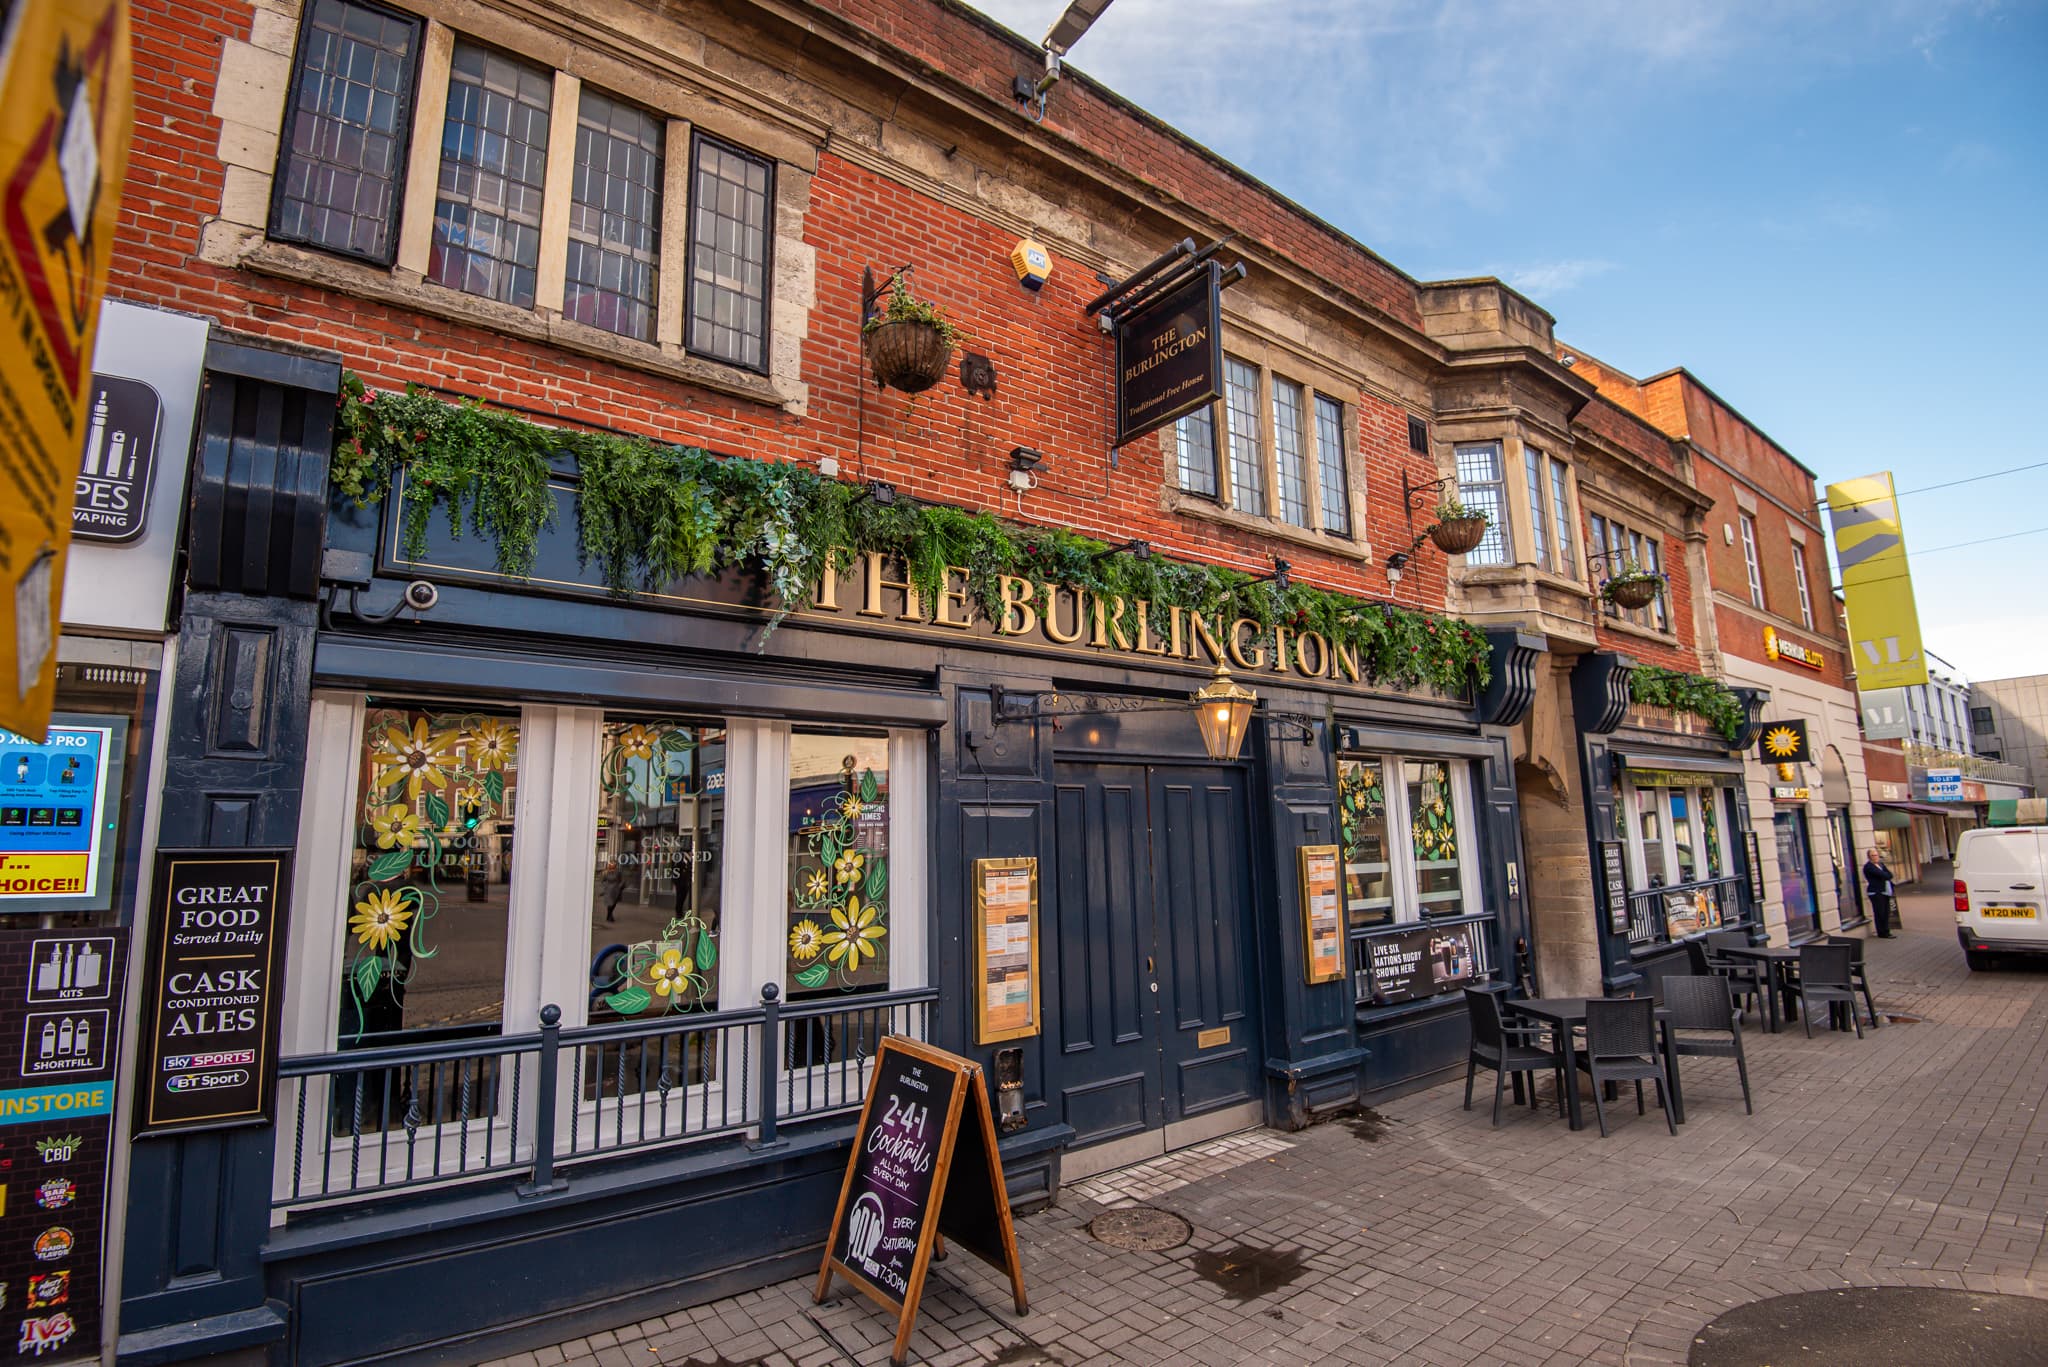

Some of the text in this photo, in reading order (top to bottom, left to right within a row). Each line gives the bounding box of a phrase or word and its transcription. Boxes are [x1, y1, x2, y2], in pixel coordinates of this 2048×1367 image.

[1152, 327, 1177, 351] THE
[1125, 326, 1208, 383] BURLINGTON
[1128, 373, 1205, 417] Traditional Free House
[72, 512, 128, 527] VAPING
[814, 545, 1360, 683] THE BURLINGTON
[8, 734, 88, 747] XRS PRO
[1941, 784, 1959, 792] FHP
[861, 812, 882, 821] TIMES
[641, 836, 681, 848] CASK
[644, 867, 681, 880] ALES
[1608, 880, 1623, 891] CASK
[176, 886, 268, 905] GREAT
[180, 908, 260, 929] FOOD
[173, 930, 264, 945] Served Daily
[1373, 943, 1400, 956] LIVE SIX
[1374, 951, 1422, 968] NATIONS RUGBY
[1375, 963, 1416, 978] SHOWN HERE
[168, 969, 261, 995] CASK
[58, 988, 85, 998] KITS
[167, 994, 260, 1010] CONDITIONED
[167, 1008, 257, 1037] ALES
[33, 1058, 94, 1071] SHORTFILL
[167, 1051, 251, 1070] sky SPORTS
[177, 1072, 240, 1089] BT Sport
[912, 1066, 922, 1078] THE
[899, 1073, 929, 1093] BURLINGTON
[882, 1094, 928, 1140] 2-4-1
[44, 1145, 72, 1163] CBD
[867, 1124, 931, 1173] Cocktails
[880, 1157, 908, 1178] ALL DAY
[873, 1165, 910, 1191] EVERY DAY
[44, 1188, 67, 1197] BAR
[892, 1216, 917, 1230] EVERY
[881, 1235, 917, 1255] SATURDAY
[38, 1248, 70, 1260] FLAVOR
[21, 1312, 74, 1343] IVG
